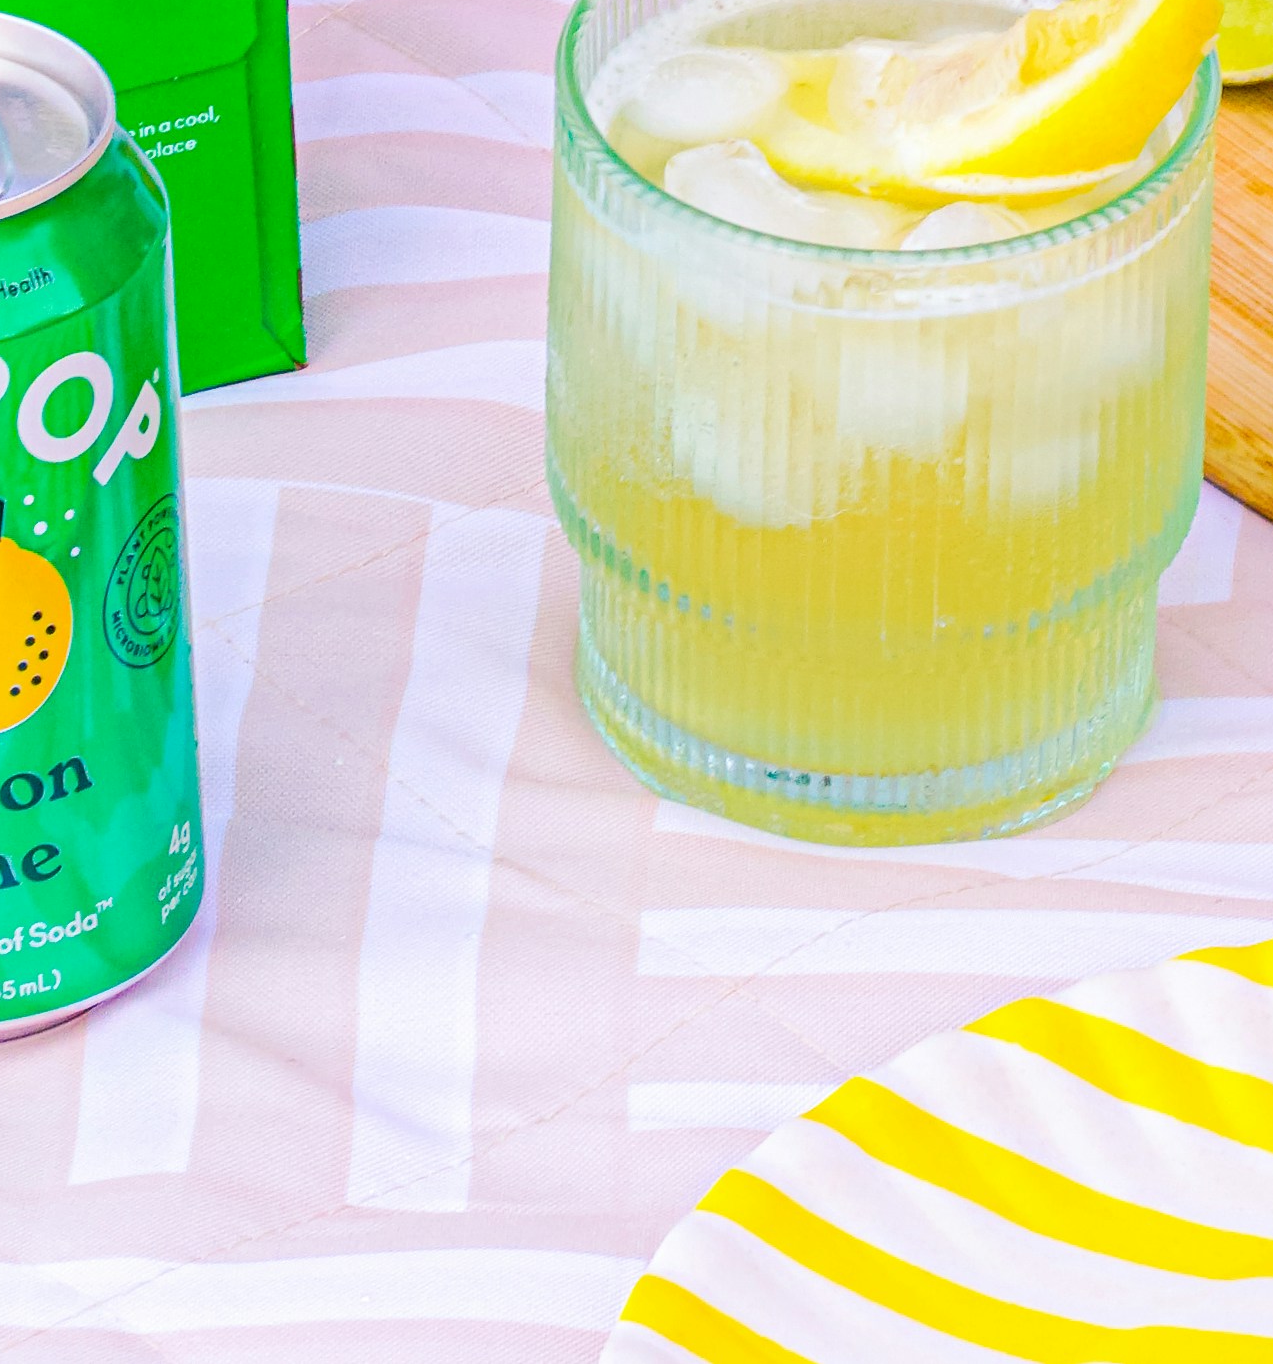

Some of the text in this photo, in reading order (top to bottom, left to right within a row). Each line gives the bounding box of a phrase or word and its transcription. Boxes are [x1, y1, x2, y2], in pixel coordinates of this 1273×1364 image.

[139, 122, 156, 138] in
[158, 120, 171, 133] a
[174, 105, 221, 130] cool,
[169, 820, 191, 855] 4g
[158, 874, 172, 901] of
[18, 969, 62, 998] mL)
